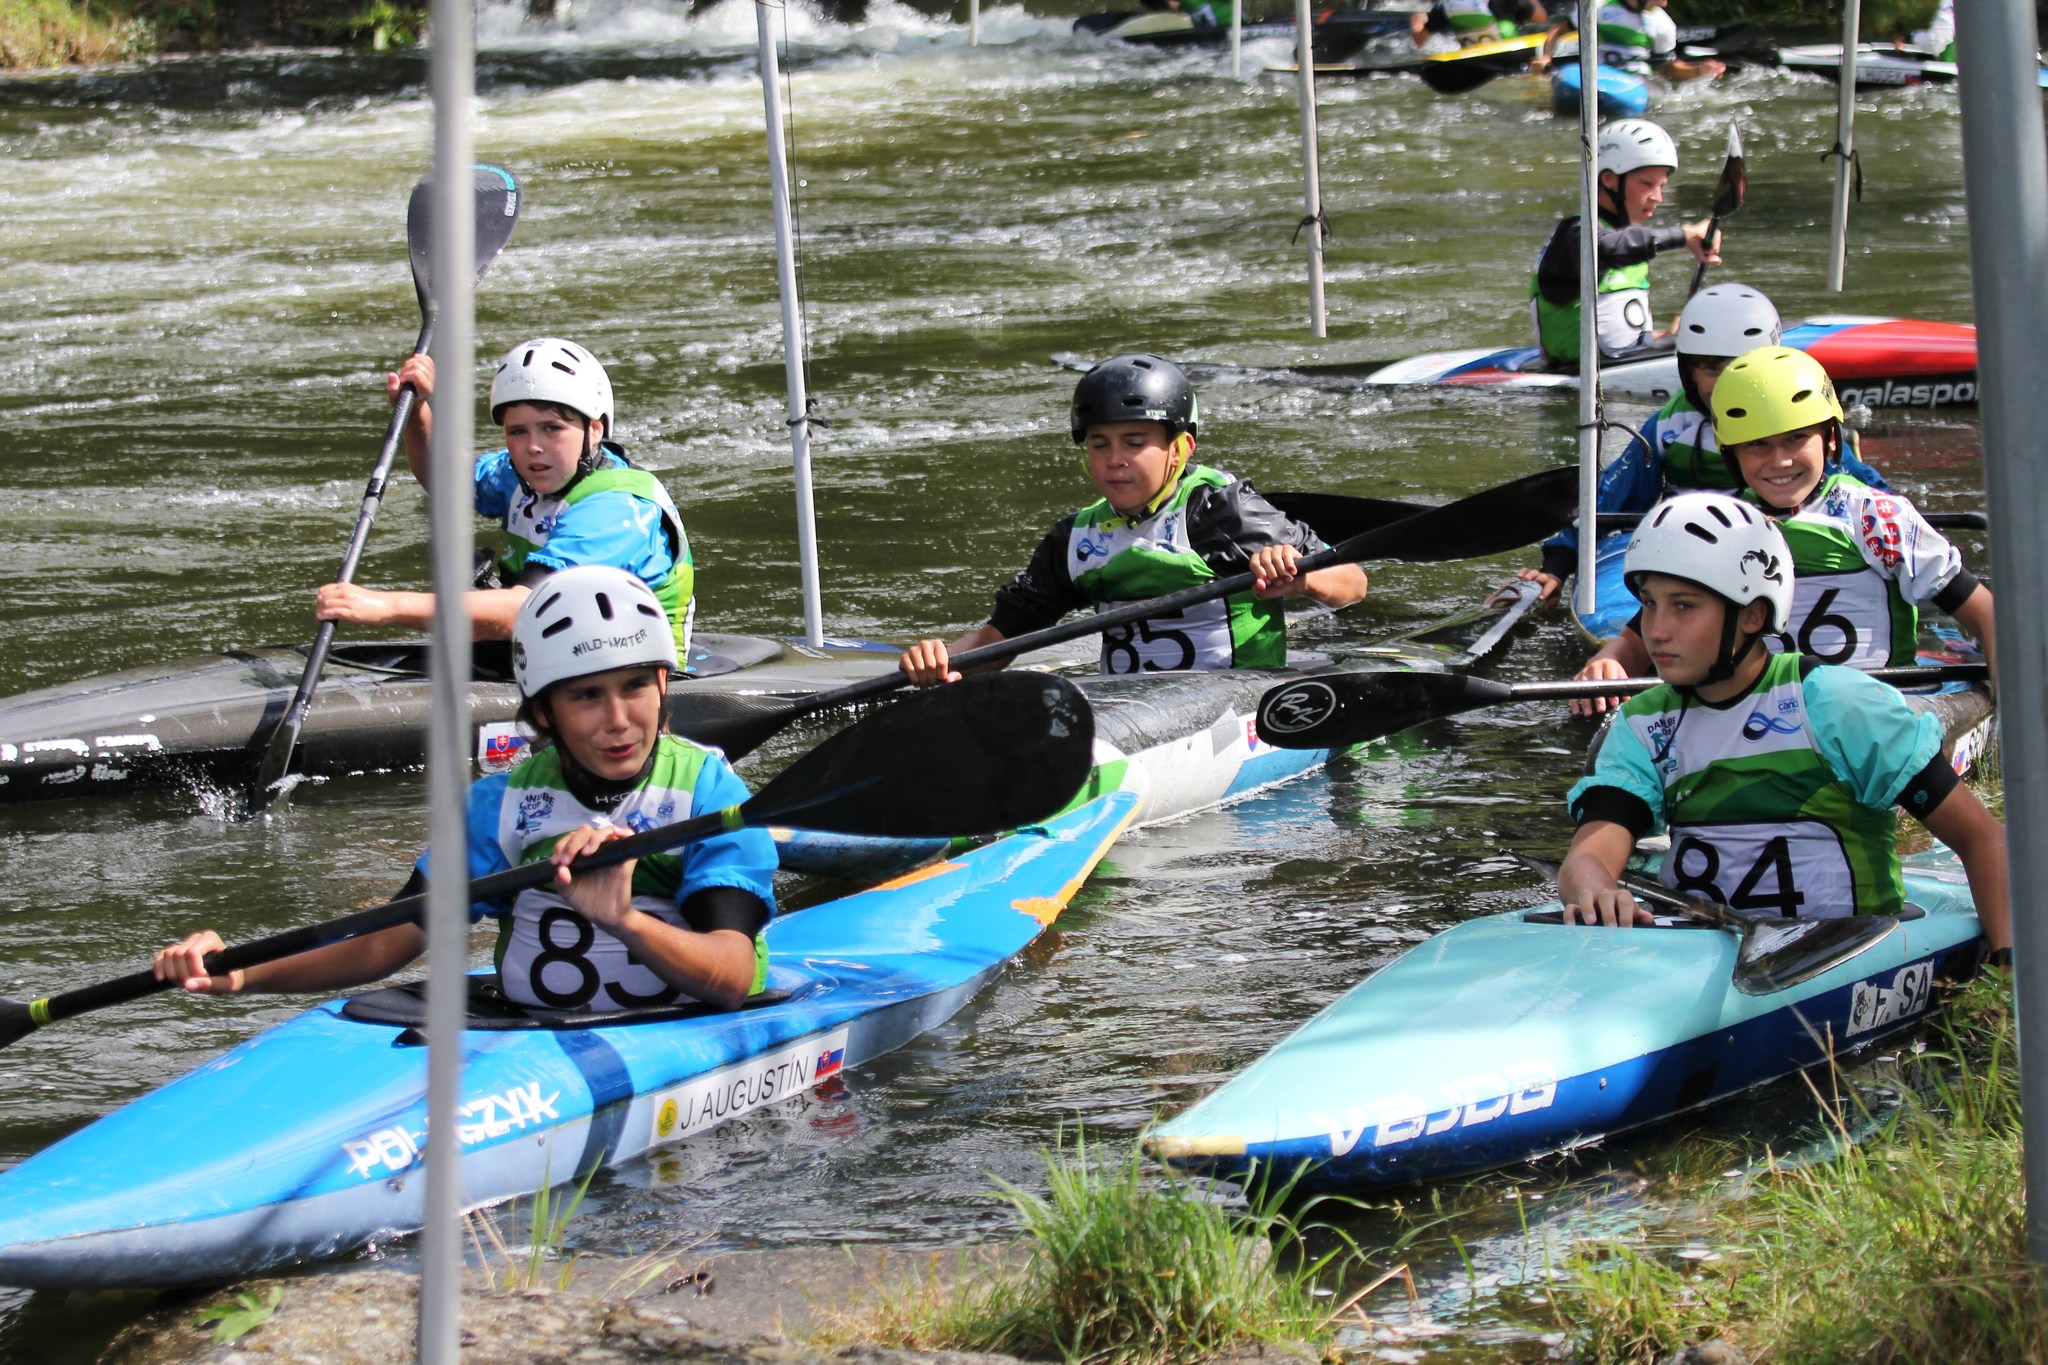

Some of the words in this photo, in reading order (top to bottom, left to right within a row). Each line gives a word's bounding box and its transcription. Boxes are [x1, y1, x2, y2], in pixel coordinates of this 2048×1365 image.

[1841, 380, 1980, 409] galaspo
[572, 628, 648, 658] WILD-WATER
[1102, 604, 1196, 675] 85
[1673, 836, 1805, 918] 84
[530, 906, 684, 1010] 83
[1898, 965, 1929, 1017] SA
[342, 1081, 560, 1180] POLCZYK
